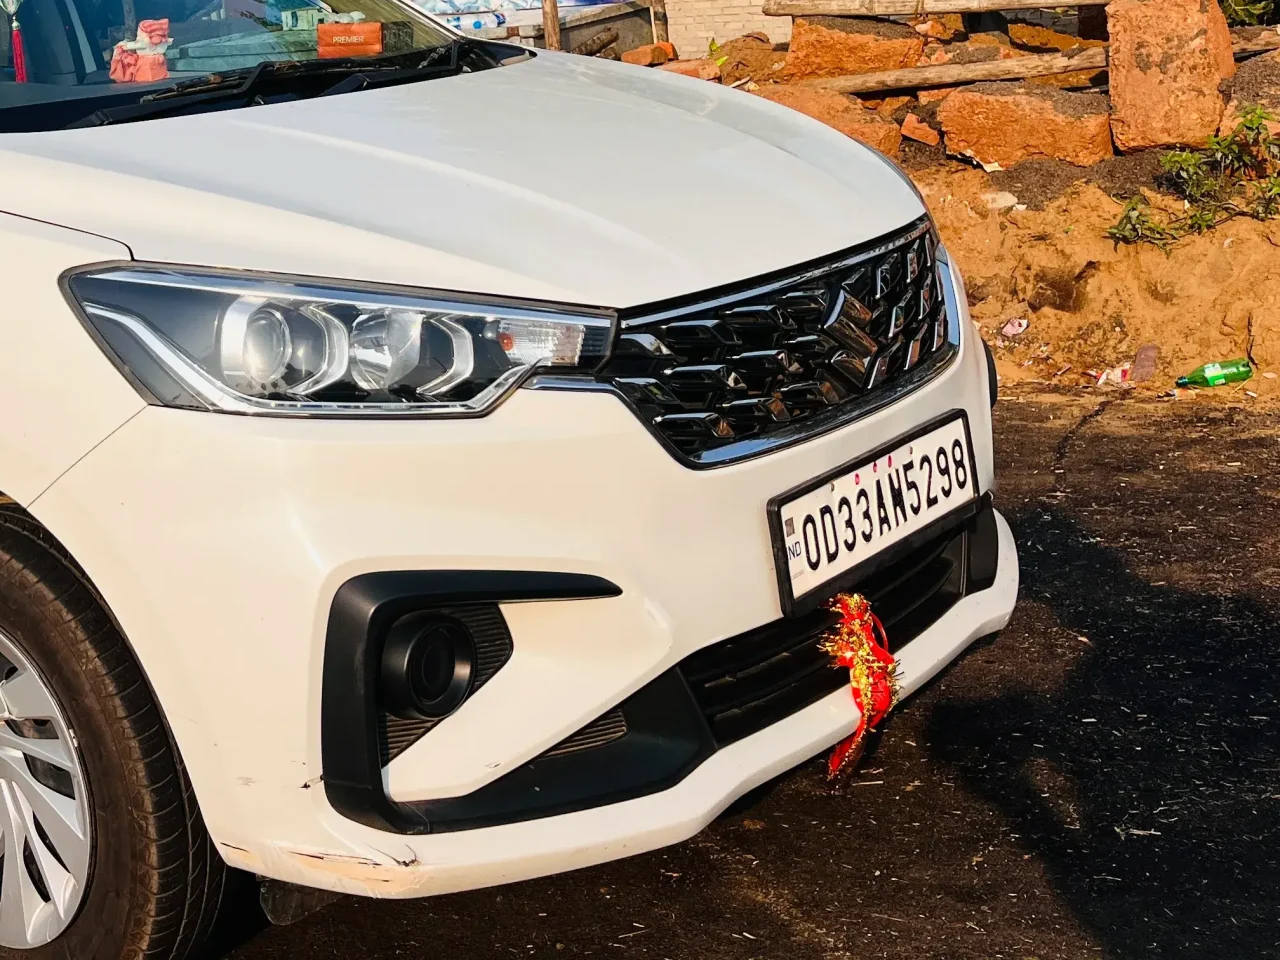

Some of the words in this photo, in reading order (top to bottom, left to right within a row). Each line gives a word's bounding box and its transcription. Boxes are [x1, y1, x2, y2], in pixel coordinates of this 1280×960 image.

[332, 35, 365, 45] PREMIER
[802, 438, 968, 571] OD33AN5298
[787, 540, 802, 561] ND
